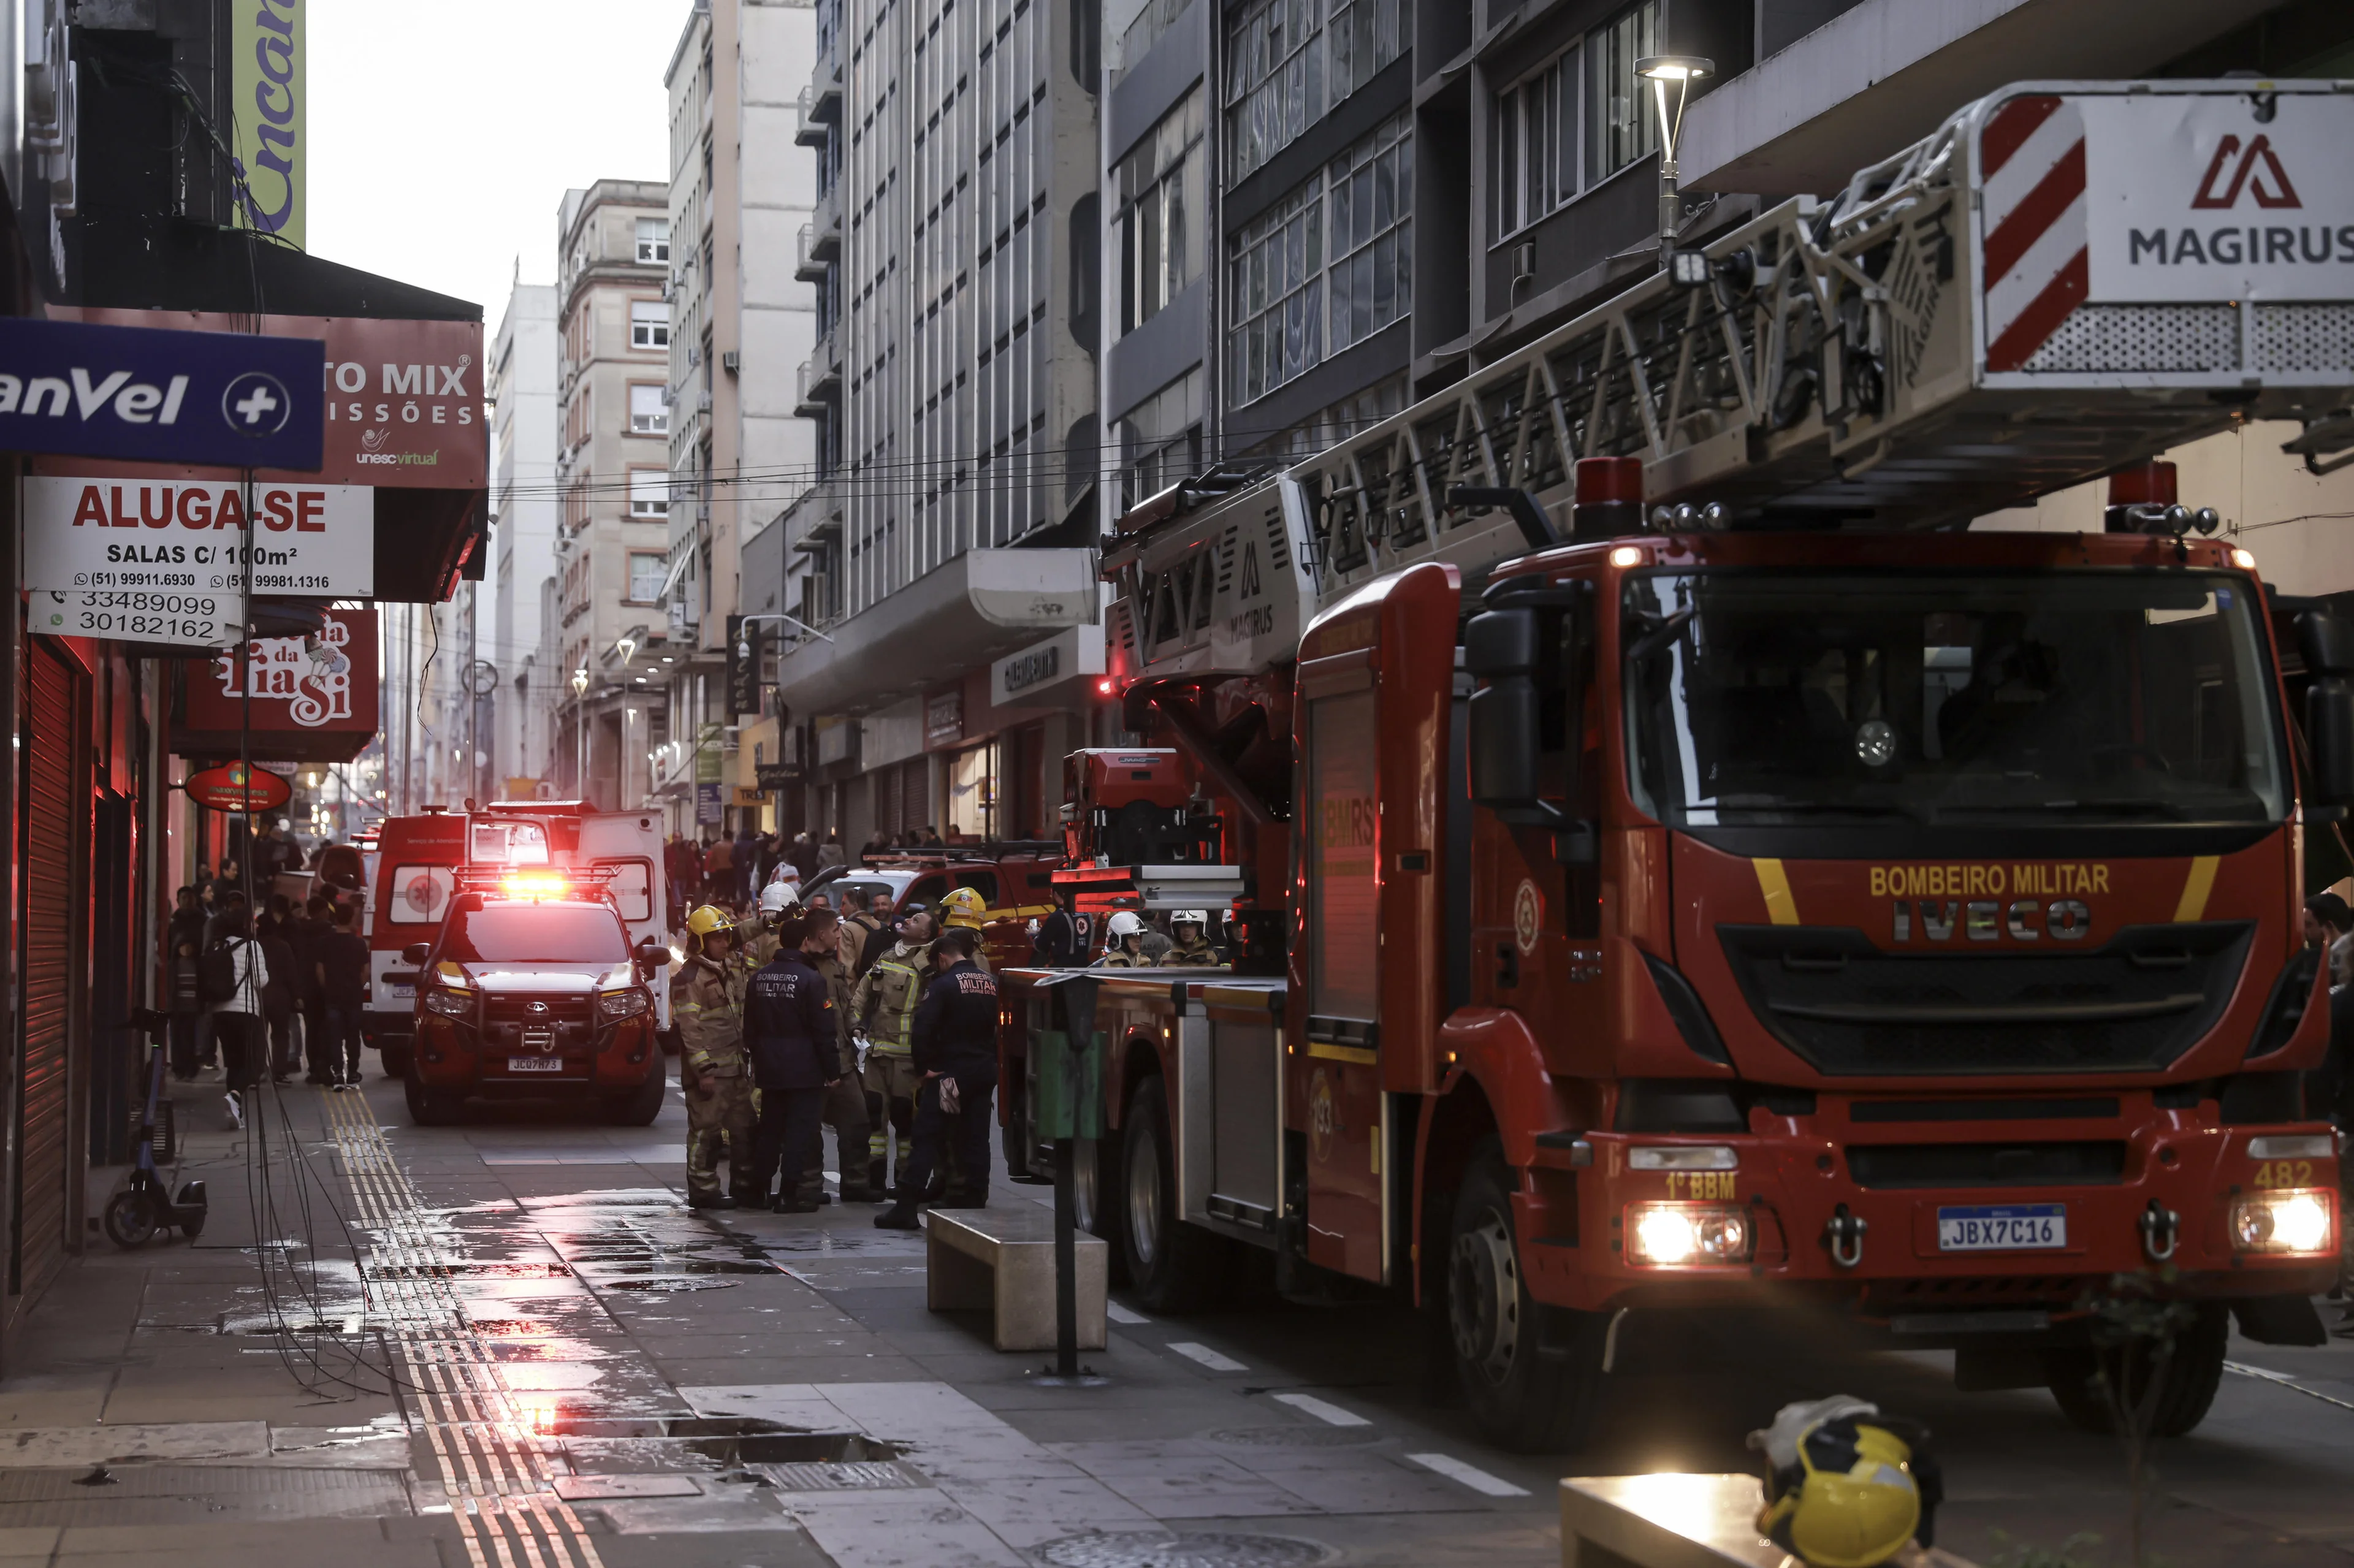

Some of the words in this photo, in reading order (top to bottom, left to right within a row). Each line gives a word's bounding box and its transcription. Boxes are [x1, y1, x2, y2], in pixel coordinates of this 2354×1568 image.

[2129, 224, 2354, 264] MAGIRUS
[383, 363, 468, 397] MIX
[329, 400, 472, 425] ISSÕES
[72, 485, 326, 532] ALUGA-SE
[107, 544, 185, 563] SALAS
[194, 546, 216, 564] C/
[91, 573, 116, 587] (51)
[121, 573, 195, 586] 99911.6930
[255, 575, 329, 588] 99981.1316
[82, 592, 215, 615] 33489099
[80, 612, 214, 638] 30182162
[1231, 604, 1273, 645] MAGIRUS
[275, 645, 299, 662] da
[1870, 865, 2006, 896] BOMBEIRO
[2013, 864, 2110, 894] MILITAR
[1892, 900, 2091, 941] IVECO
[756, 973, 798, 982] BOMBEIRO
[756, 983, 796, 992] MILITAR
[956, 972, 994, 982] BOMBEIRO
[959, 979, 996, 992] MILITAR
[514, 1060, 557, 1069] JCQ7H73
[1689, 1171, 1735, 1200] BBM
[2253, 1160, 2313, 1189] 482
[1952, 1219, 2052, 1245] JBX7C16
